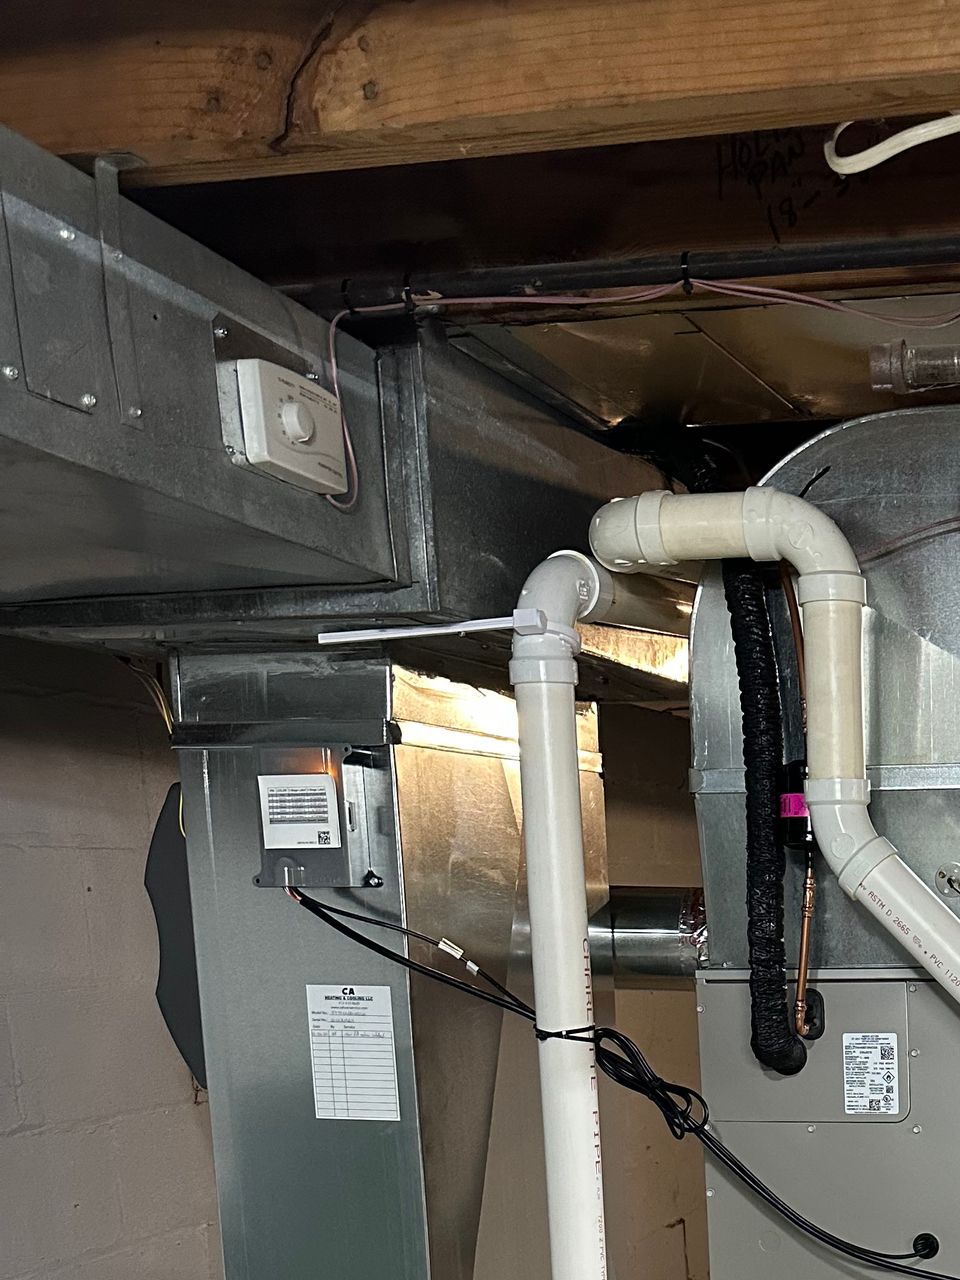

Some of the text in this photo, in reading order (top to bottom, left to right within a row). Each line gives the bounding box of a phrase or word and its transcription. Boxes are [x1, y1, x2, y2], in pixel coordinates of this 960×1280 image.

[868, 890, 886, 909] ASTM
[885, 909, 893, 917] D
[893, 916, 911, 935] 2665
[929, 953, 943, 968] PVC
[341, 987, 355, 996] CA
